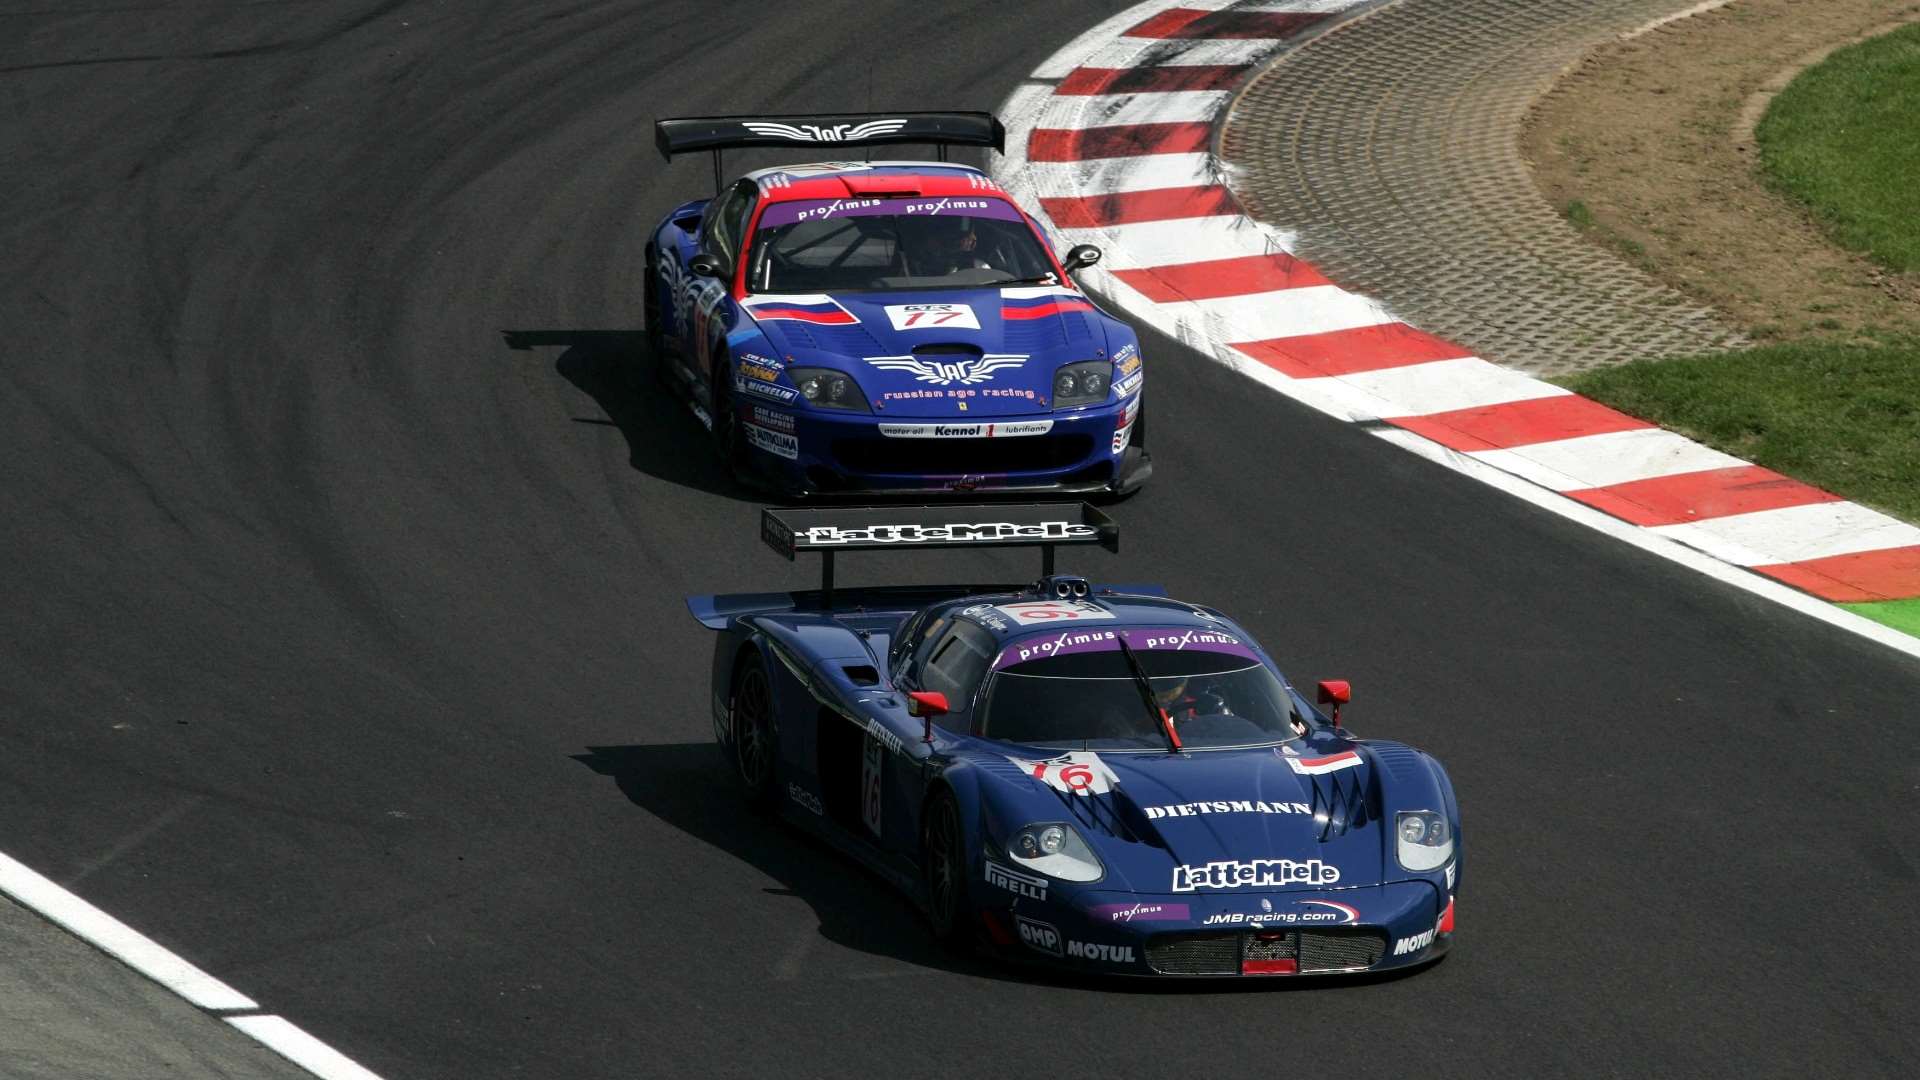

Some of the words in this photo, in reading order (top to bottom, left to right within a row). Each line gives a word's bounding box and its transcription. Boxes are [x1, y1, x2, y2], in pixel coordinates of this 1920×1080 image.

[798, 199, 880, 220] proximus
[906, 198, 988, 215] proximus
[904, 311, 964, 326] 17
[747, 381, 794, 400] MICHELIN
[884, 390, 943, 399] russian
[948, 389, 976, 399] age
[982, 388, 1035, 399] racing
[757, 429, 797, 450] AUTOCLIMA
[935, 425, 981, 437] Kennol
[1005, 424, 1047, 434] lubrifiants
[1019, 632, 1115, 661] proximus
[1146, 630, 1239, 650] proximus
[1144, 800, 1313, 819] DIETSMANN
[984, 860, 1049, 901] PIRELLI
[1112, 903, 1162, 922] proximus
[1020, 923, 1058, 946] OMP
[1067, 940, 1136, 963] MOTUL
